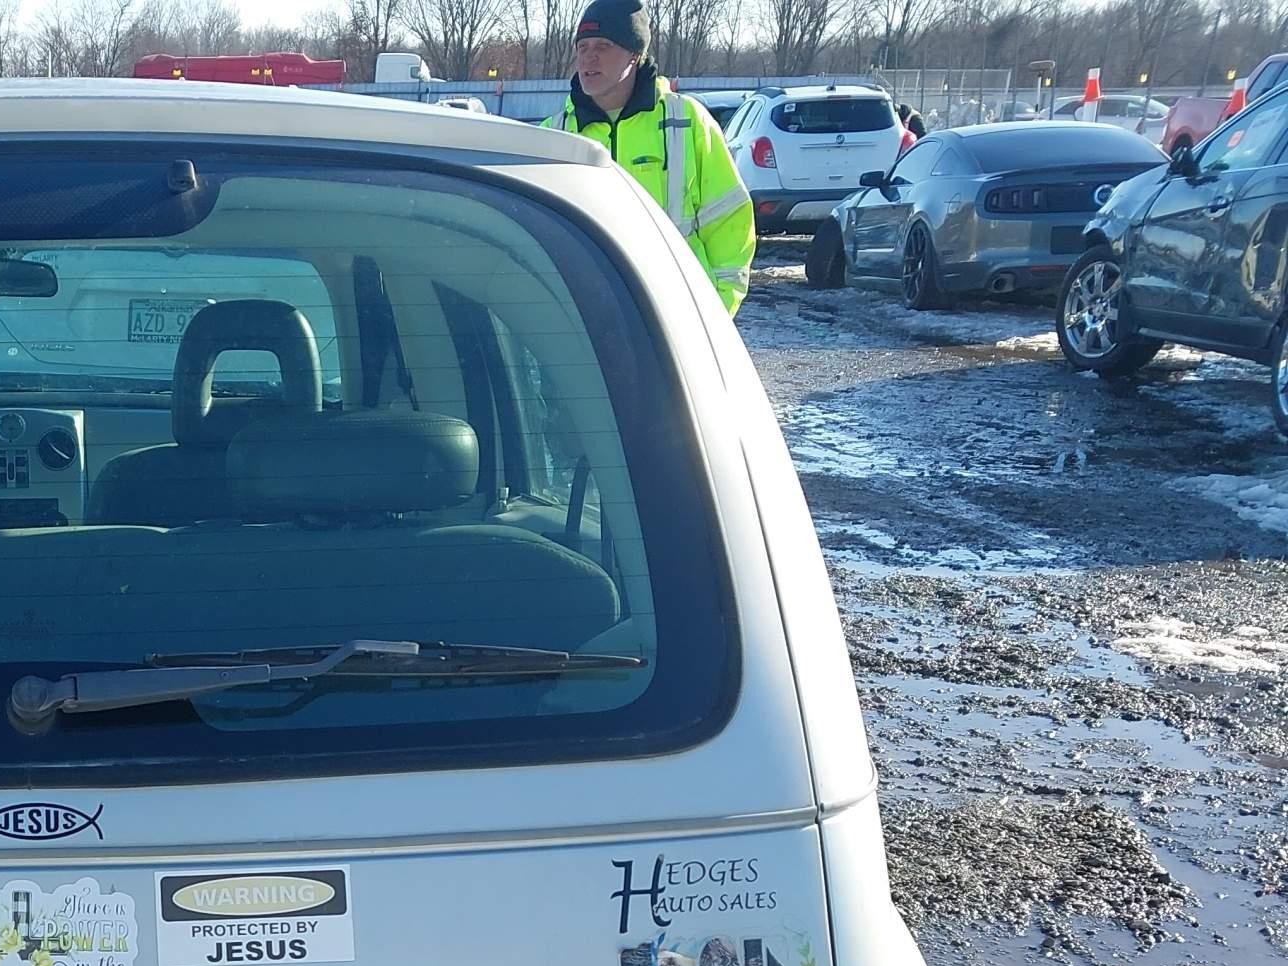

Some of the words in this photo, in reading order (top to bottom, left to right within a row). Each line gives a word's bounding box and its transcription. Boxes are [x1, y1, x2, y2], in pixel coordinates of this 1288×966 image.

[132, 312, 165, 333] AZD
[192, 884, 316, 907] WARNING
[610, 854, 759, 934] HEDGES
[654, 894, 713, 914] AUTO
[718, 891, 777, 912] SALES
[114, 902, 126, 915] is
[39, 919, 130, 952] POWER
[191, 922, 291, 938] PROTECTED
[296, 921, 318, 934] BY
[206, 939, 308, 964] JESUS
